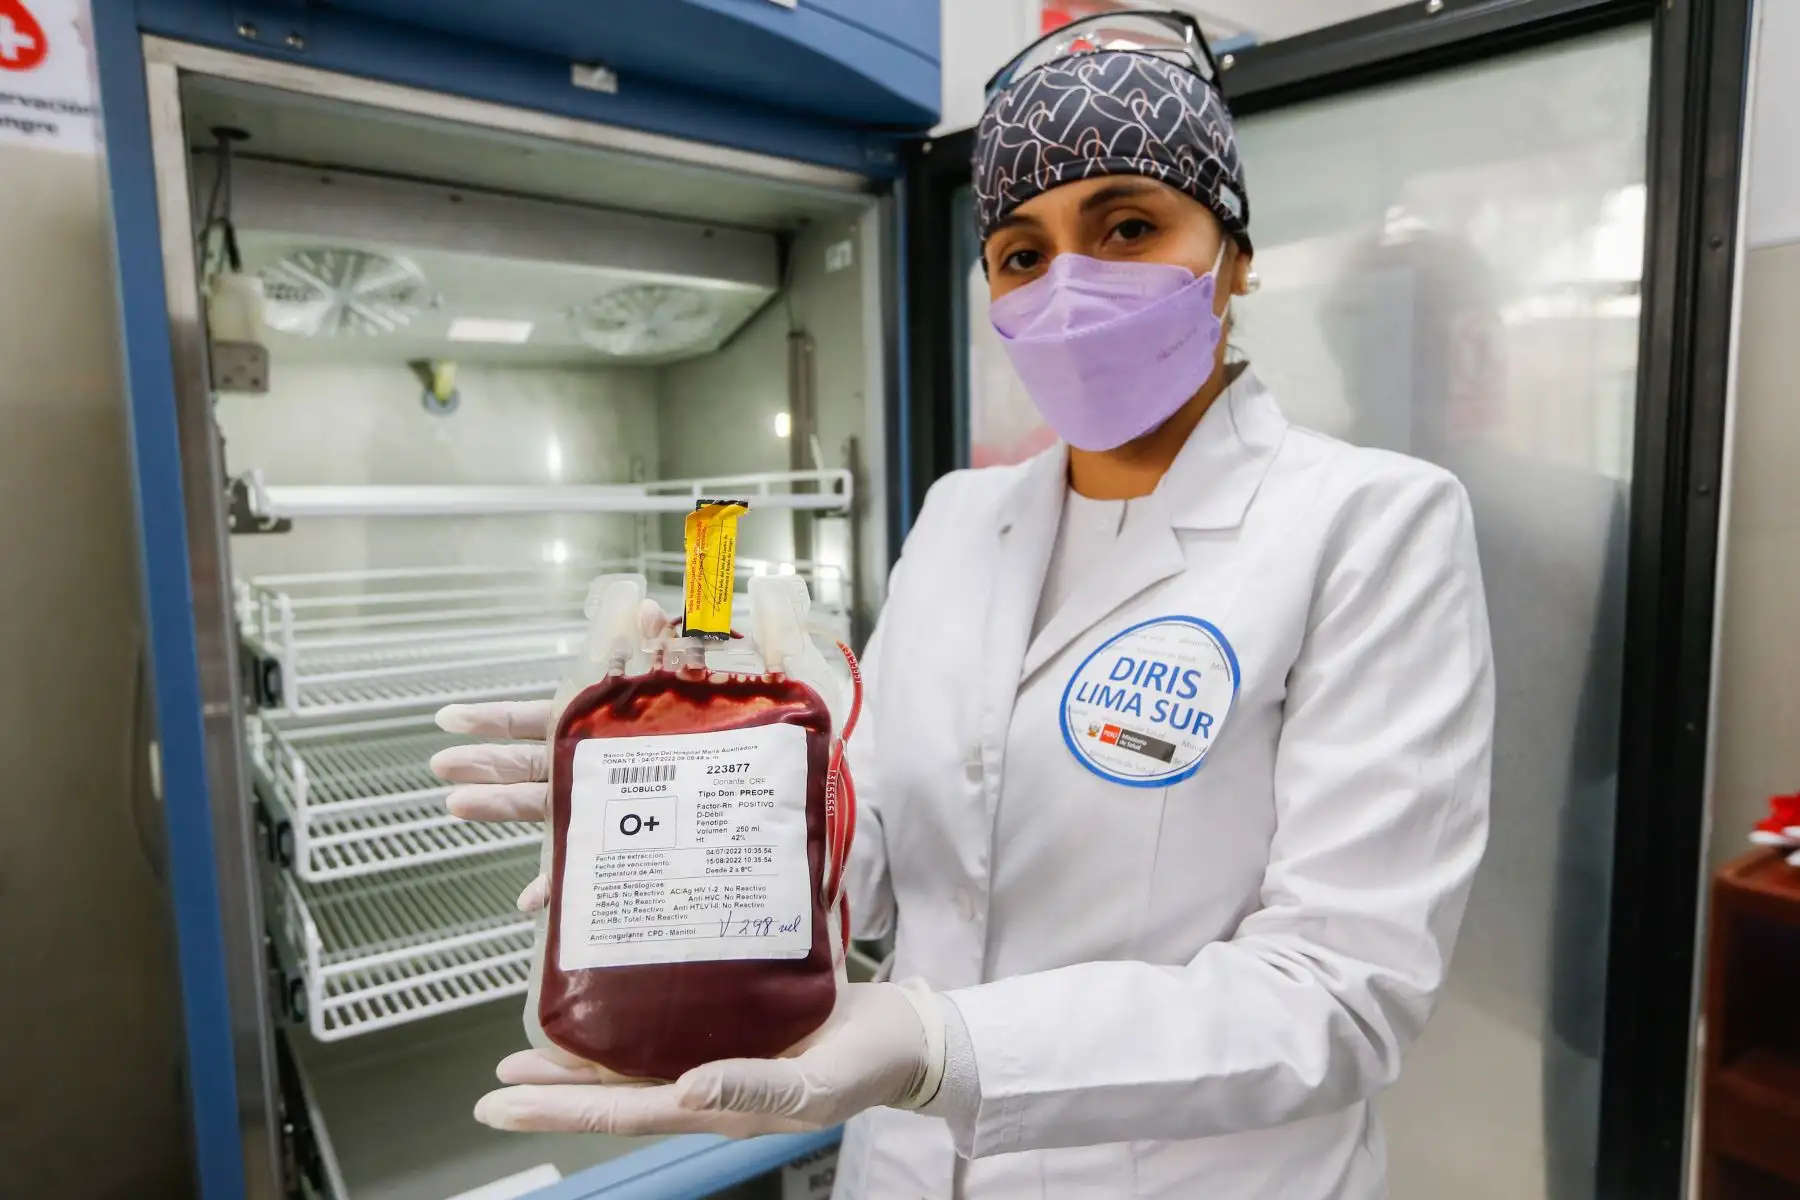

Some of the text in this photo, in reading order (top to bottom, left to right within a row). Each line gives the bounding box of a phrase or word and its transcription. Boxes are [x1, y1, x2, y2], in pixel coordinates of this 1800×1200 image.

[1108, 656, 1202, 700] DIRIS
[1076, 681, 1142, 718] LIMA
[1150, 699, 1214, 740] SUR
[706, 763, 750, 775] 223877
[620, 784, 667, 794] GLOBULOS
[698, 790, 717, 798] Tipo
[718, 789, 737, 797] Don:
[620, 813, 660, 836] O+
[736, 825, 749, 833] 250
[705, 847, 742, 856] 04/07/2022
[706, 857, 742, 865] 15/08/2022
[595, 870, 637, 878] Temperatura
[670, 887, 693, 895] AC/Ag
[734, 901, 765, 909] Reactivo
[633, 906, 664, 914] Reactivo
[607, 916, 622, 924] HBc
[657, 913, 688, 921] Reactivo
[738, 916, 773, 937] 298
[669, 928, 696, 936] Manitol
